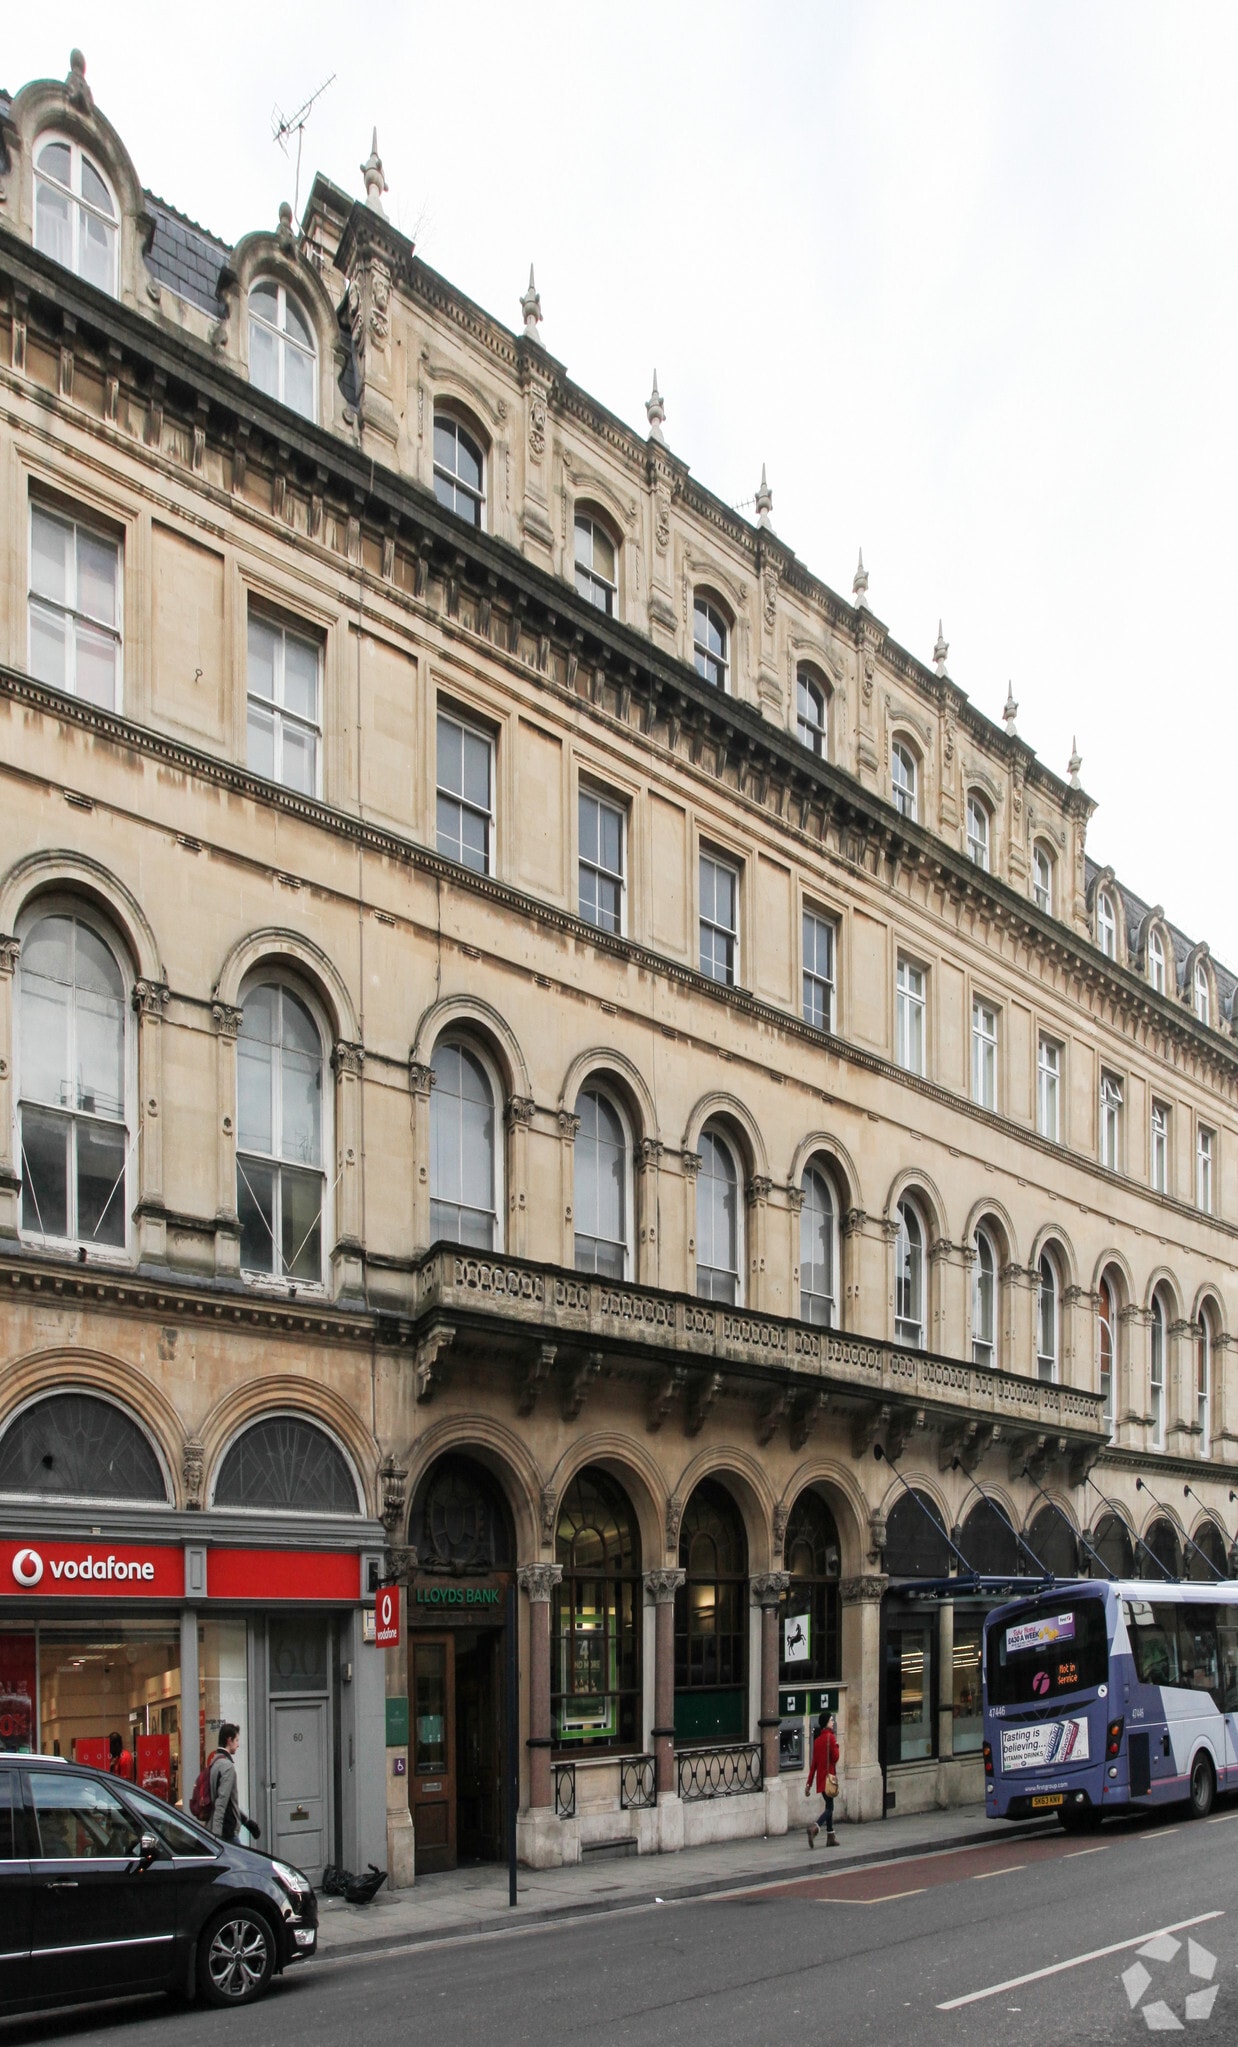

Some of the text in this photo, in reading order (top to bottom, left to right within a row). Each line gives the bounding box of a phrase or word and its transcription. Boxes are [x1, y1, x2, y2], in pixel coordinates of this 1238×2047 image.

[50, 1555, 154, 1580] vodafone
[416, 1587, 499, 1603] LLOYDS BANK
[377, 1627, 397, 1640] vodafone
[1059, 1663, 1076, 1674] Not in
[1057, 1674, 1078, 1685] Service
[989, 1706, 1006, 1718] 47446
[293, 1733, 303, 1742] 60
[1003, 1728, 1040, 1742] Tasting is
[1023, 1751, 1044, 1760] DRINKS
